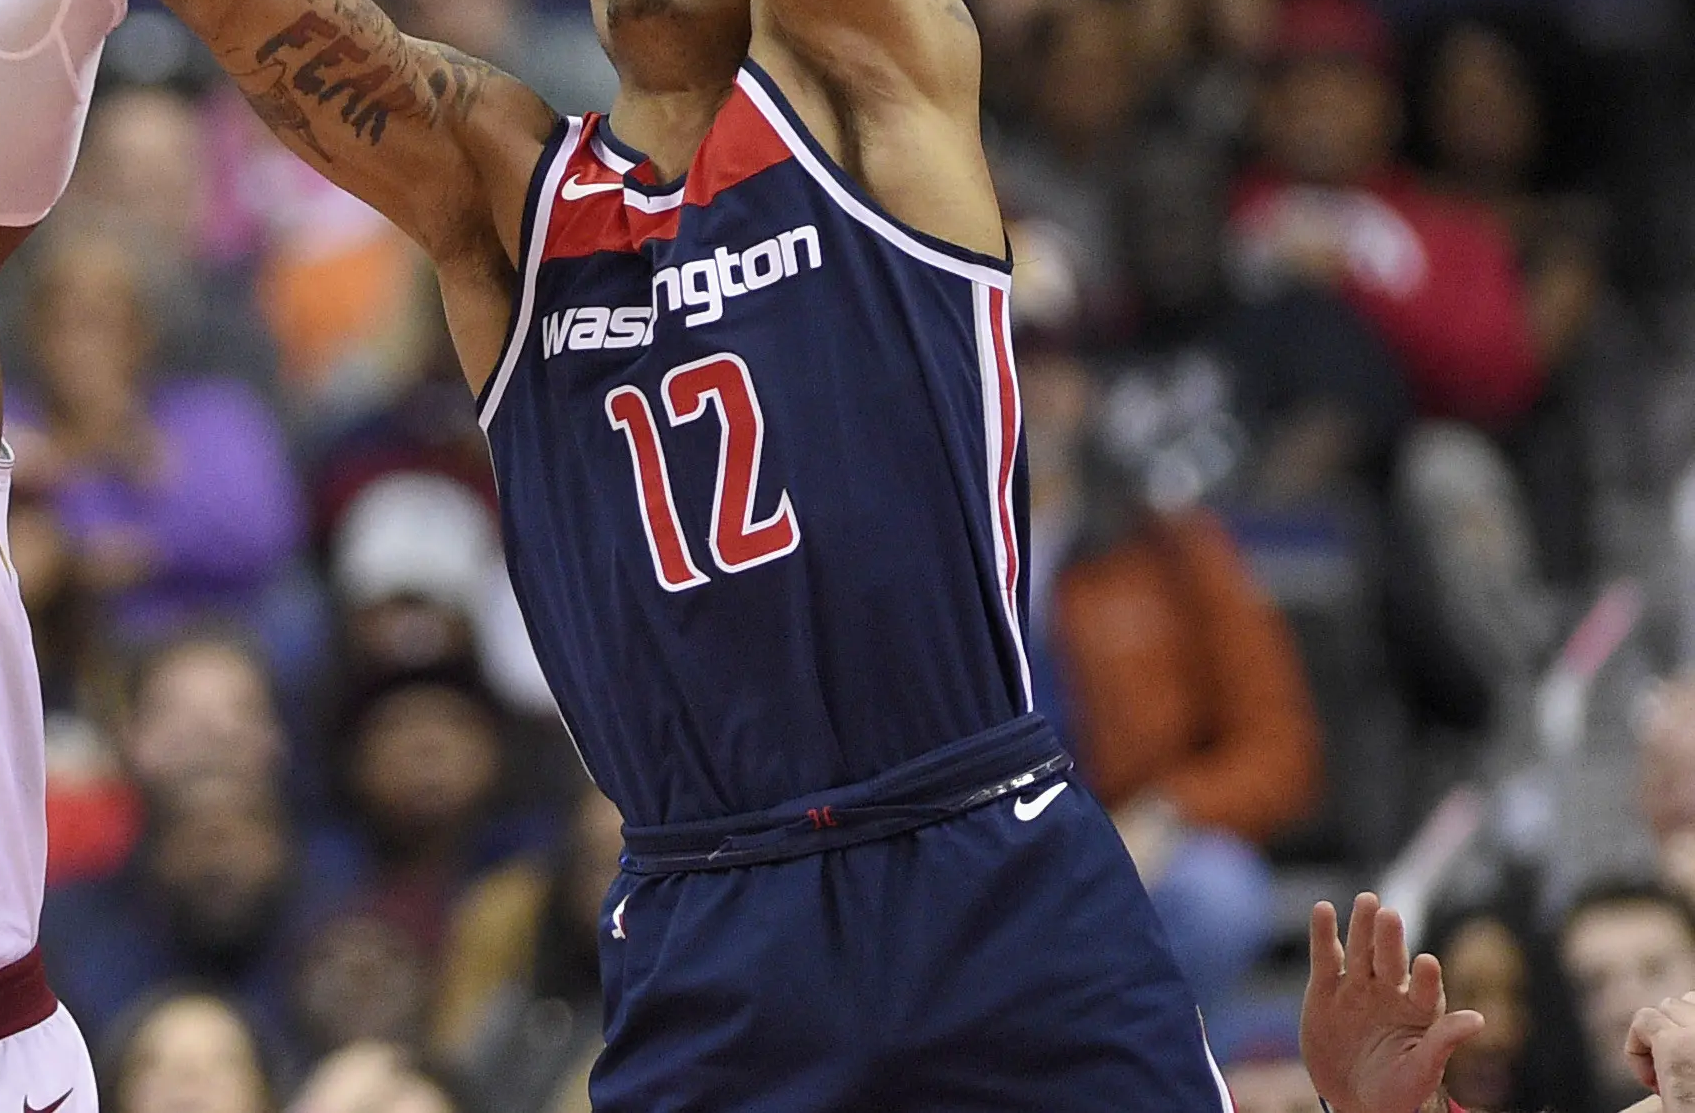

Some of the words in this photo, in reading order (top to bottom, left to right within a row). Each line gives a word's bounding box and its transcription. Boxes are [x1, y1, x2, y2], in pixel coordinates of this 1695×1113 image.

[255, 9, 417, 147] FEAR
[542, 224, 822, 360] wasngton
[605, 351, 801, 592] 12
